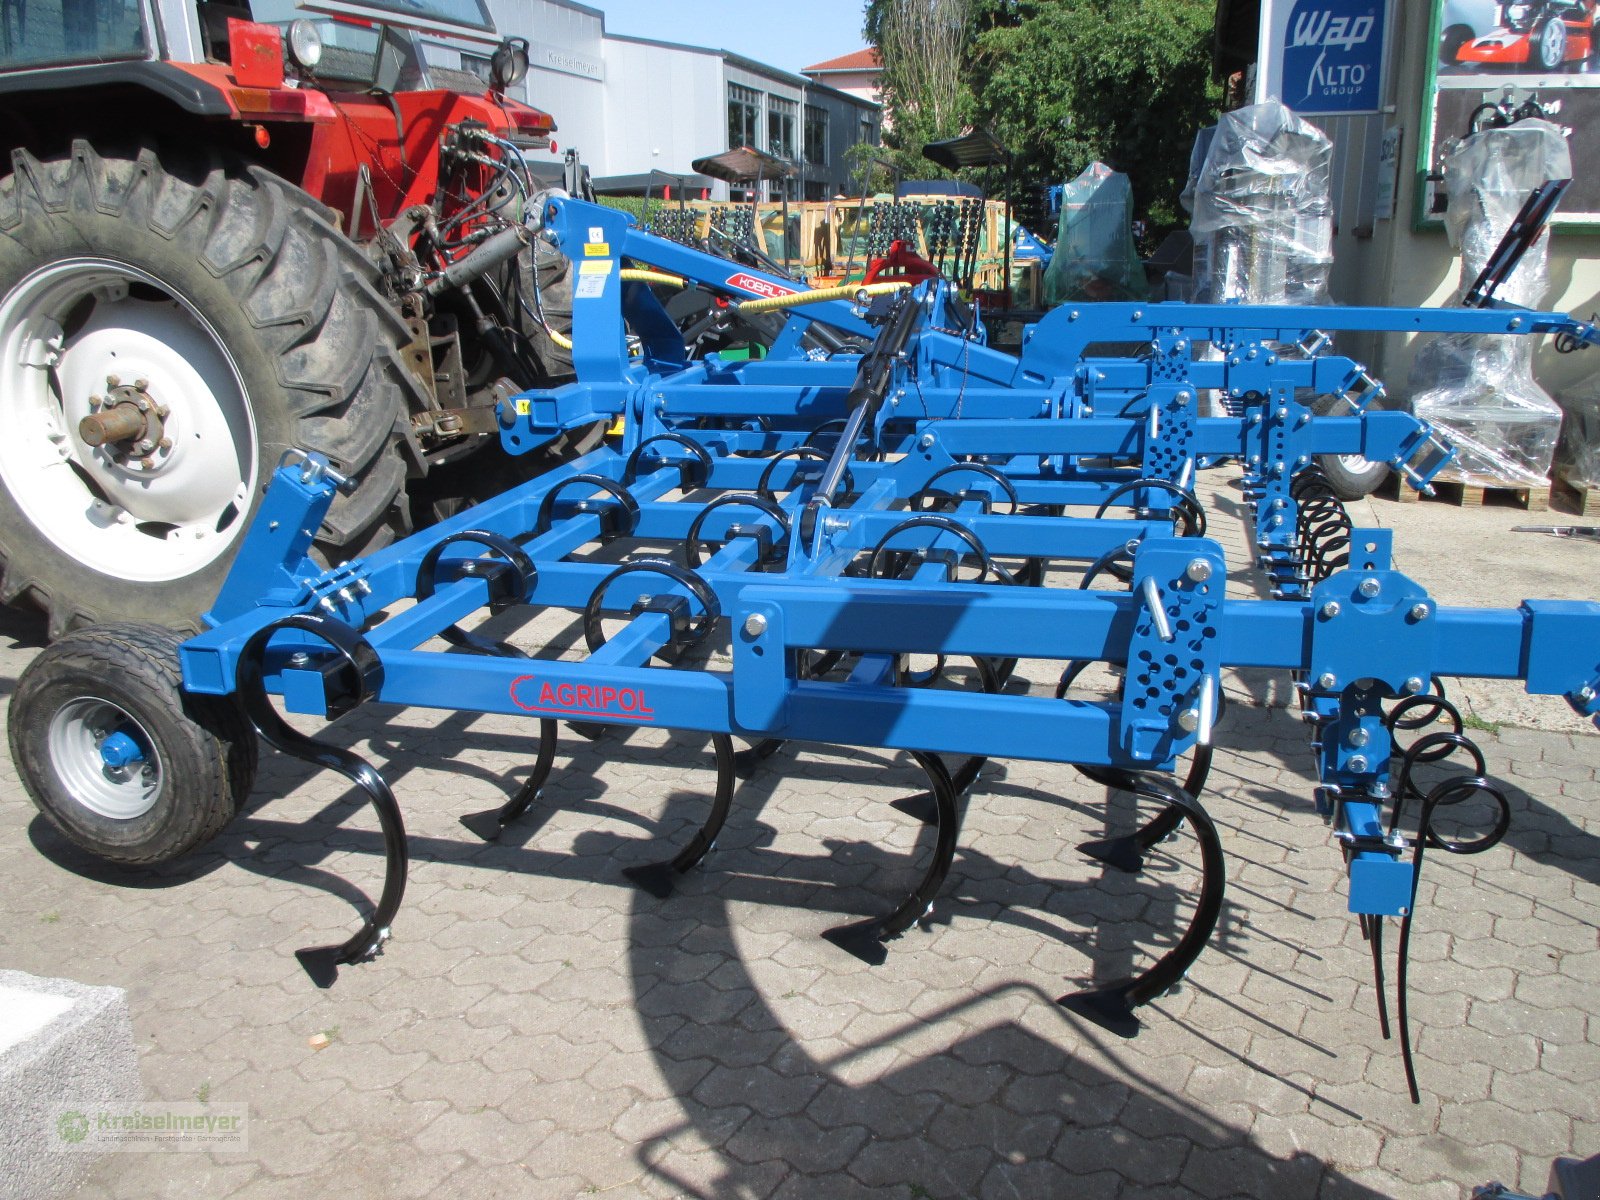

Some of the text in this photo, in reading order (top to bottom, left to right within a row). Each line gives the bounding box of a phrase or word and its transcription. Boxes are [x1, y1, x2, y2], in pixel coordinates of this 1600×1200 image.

[1293, 10, 1375, 51] Wap
[548, 51, 599, 73] Kreiselmeyer
[1307, 56, 1366, 94] ALTO
[1323, 86, 1362, 96] GROUP
[539, 681, 655, 713] AGRIPOL
